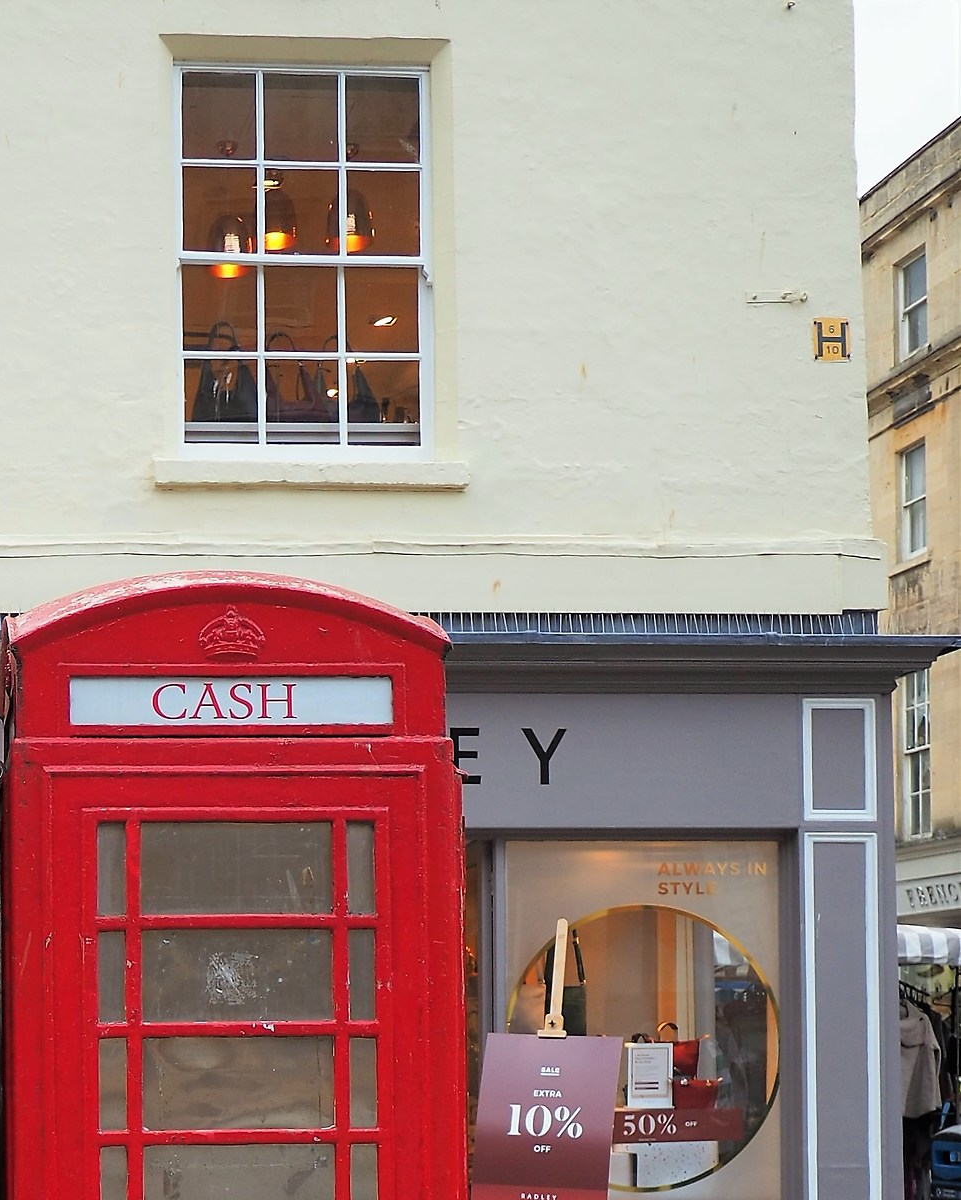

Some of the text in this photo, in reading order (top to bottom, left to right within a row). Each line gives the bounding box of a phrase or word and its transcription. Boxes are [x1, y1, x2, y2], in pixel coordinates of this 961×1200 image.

[829, 325, 835, 334] 6
[826, 345, 839, 354] 10
[151, 682, 297, 721] CASH
[657, 862, 768, 877] ALWAYS IN
[657, 881, 717, 896] STYLE
[905, 883, 961, 909] FRENC
[540, 1066, 561, 1074] SALE
[533, 1089, 563, 1099] EXTRA
[506, 1103, 584, 1140] 10%
[623, 1113, 698, 1136] 50% OFF
[533, 1144, 552, 1154] OFF
